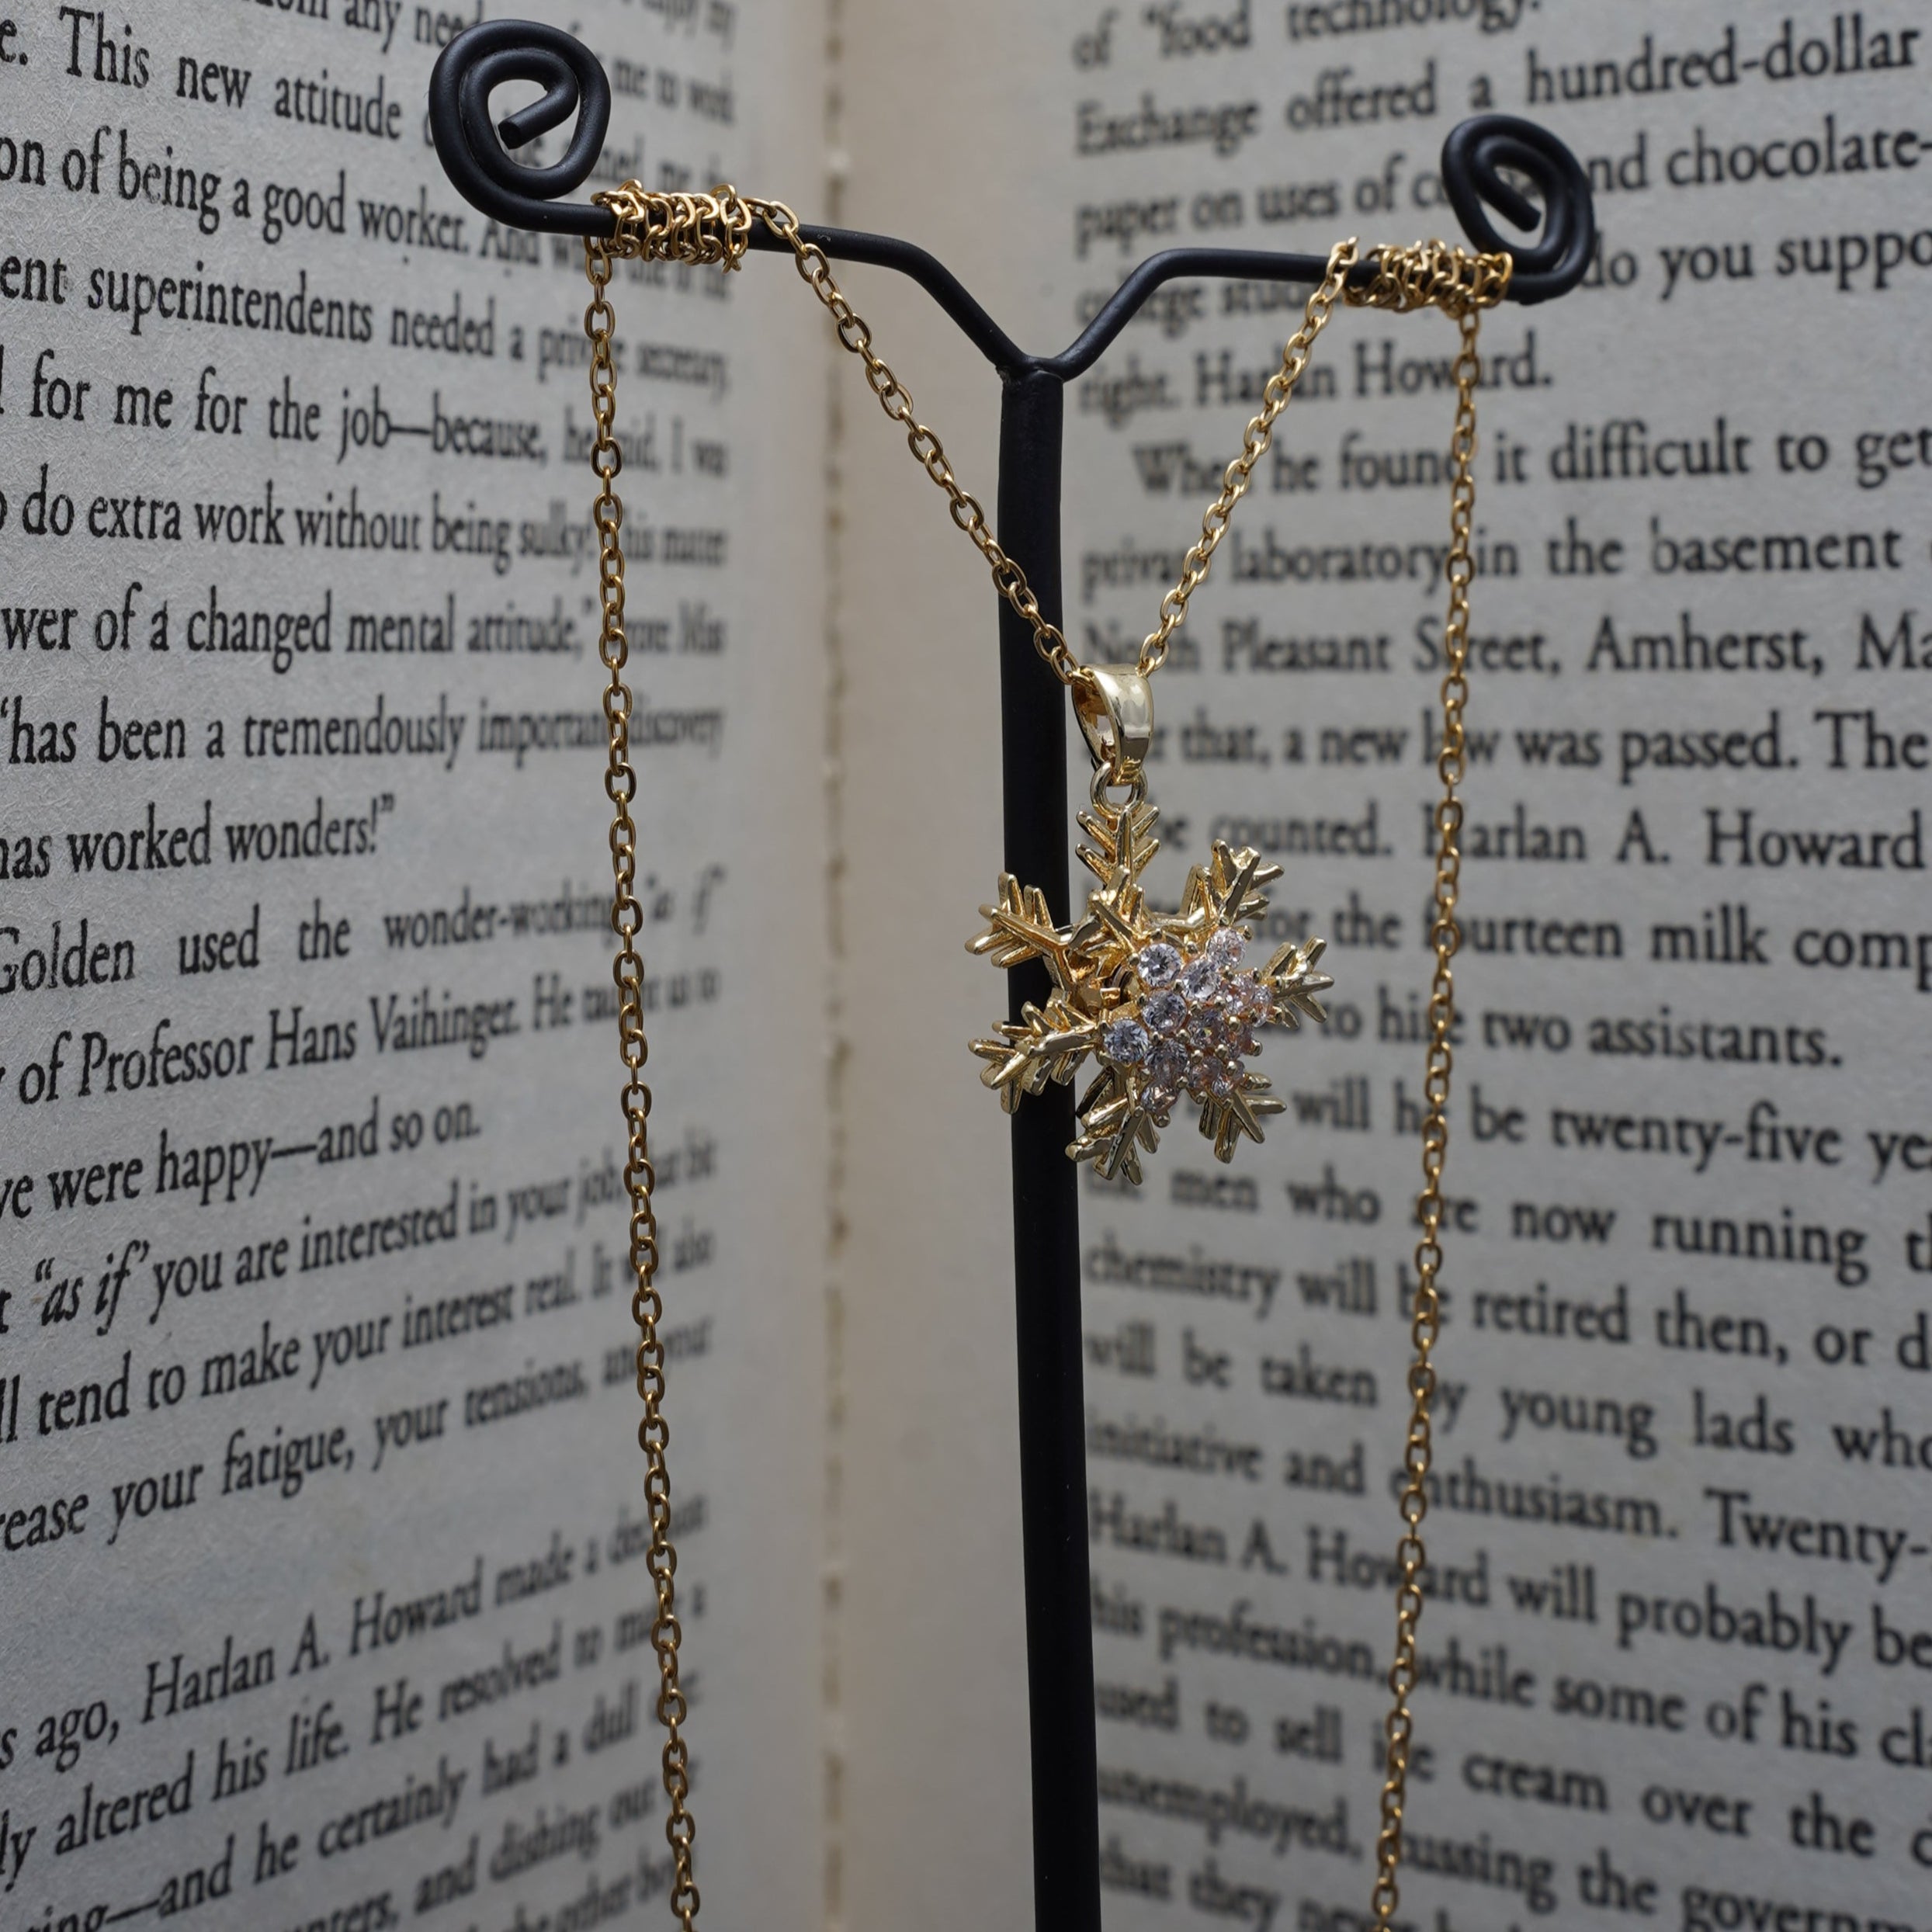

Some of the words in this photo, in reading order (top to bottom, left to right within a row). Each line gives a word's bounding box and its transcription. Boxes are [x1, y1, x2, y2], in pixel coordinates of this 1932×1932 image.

[60, 6, 151, 88] This
[176, 55, 252, 109] new
[275, 70, 401, 141] attitude
[344, 0, 402, 54] any
[1286, 58, 1438, 130] offered
[1470, 73, 1493, 110] a
[1525, 12, 1921, 106] hundred-dollar
[62, 126, 111, 194] of
[119, 129, 221, 234] being
[234, 178, 251, 218] a
[262, 170, 346, 244] good
[359, 186, 470, 254] worker.
[1191, 191, 1243, 229] on
[1257, 182, 1341, 224] uses
[1354, 154, 1407, 214] of
[1667, 113, 1932, 186] chocolate-
[0, 254, 68, 306] ent
[87, 261, 373, 336] superintendents
[390, 292, 496, 357] needed
[509, 327, 523, 360] a
[1659, 242, 1754, 301] you
[29, 349, 90, 421] for
[113, 383, 173, 428] me
[195, 366, 248, 433] for
[269, 375, 321, 441] the
[1271, 432, 1320, 493] he
[1494, 432, 1528, 485] it
[1549, 414, 1753, 482] difficult
[1777, 433, 1830, 473] to
[22, 463, 75, 537] do
[88, 496, 181, 540] extra
[196, 480, 285, 544] work
[296, 485, 422, 550] without
[431, 492, 511, 576] being
[1231, 525, 1450, 595] laboratory
[1475, 525, 1520, 578] in
[1548, 515, 1625, 578] the
[1649, 514, 1903, 575] basement
[94, 581, 142, 651] of
[150, 601, 169, 652] a
[187, 585, 331, 674] changed
[345, 591, 455, 653] mental
[1219, 617, 1393, 674] Pleasant
[1586, 611, 1826, 678] Amherst,
[98, 695, 186, 762] been
[206, 720, 224, 758] a
[244, 692, 467, 772] tremendously
[1285, 728, 1304, 763] a
[1318, 725, 1410, 764] new
[1514, 727, 1604, 770] was
[1618, 708, 1798, 788] passed.
[1814, 708, 1931, 771] The
[68, 800, 211, 872] worked
[226, 794, 395, 863] wonders!”
[1615, 805, 1670, 865] A.
[1704, 807, 1927, 871] Howard
[179, 903, 260, 975] used
[299, 898, 351, 962] the
[1331, 890, 1403, 949] the
[1648, 903, 1770, 966] milk
[19, 1031, 72, 1105] of
[78, 1018, 254, 1097] Professor
[265, 1007, 356, 1070] Hans
[370, 987, 519, 1059] Vaihinger.
[532, 973, 573, 1031] He
[1320, 998, 1362, 1040] to
[1482, 1010, 1573, 1052] two
[1587, 1004, 1844, 1070] assistants.
[48, 1157, 144, 1212] were
[390, 1107, 423, 1151] so
[435, 1101, 482, 1143] on.
[1292, 1077, 1372, 1132] will
[1472, 1081, 1526, 1143] be
[1550, 1098, 1844, 1174] twenty-five
[35, 1257, 83, 1327] “as
[150, 1252, 223, 1324] you
[236, 1243, 290, 1286] are
[300, 1179, 459, 1274] interested
[470, 1181, 496, 1234] in
[505, 1178, 570, 1240] your
[1288, 1163, 1382, 1226] who
[1510, 1200, 1617, 1243] now
[1652, 1208, 1870, 1289] running
[38, 1351, 130, 1437] tend
[147, 1365, 185, 1410] to
[201, 1321, 301, 1396] make
[310, 1316, 393, 1390] your
[402, 1285, 515, 1350] interest
[1296, 1257, 1379, 1316] will
[1472, 1282, 1631, 1346] retired
[1656, 1288, 1789, 1366] then,
[1813, 1323, 1874, 1366] or
[1182, 1326, 1234, 1389] be
[1261, 1341, 1380, 1407] taken
[1499, 1387, 1658, 1461] young
[1692, 1387, 1796, 1456] lads
[0, 1493, 88, 1552] ease
[107, 1463, 203, 1545] your
[222, 1428, 354, 1498] fatigue,
[373, 1396, 449, 1471] your
[1285, 1441, 1367, 1497] and
[1703, 1486, 1929, 1585] Twenty-
[0, 1728, 16, 1771] s
[36, 1701, 120, 1772] ago,
[141, 1635, 275, 1724] Harlan
[290, 1612, 329, 1677] A.
[349, 1555, 483, 1656] Howard
[496, 1530, 575, 1606] made
[1507, 1564, 1597, 1626] will
[1618, 1583, 1853, 1677] probably
[1871, 1603, 1932, 1670] be
[55, 1750, 195, 1856] altered
[212, 1739, 269, 1802] his
[286, 1702, 349, 1776] life.
[371, 1677, 424, 1744] He
[439, 1619, 561, 1722] resolved
[1554, 1676, 1687, 1733] some
[1706, 1683, 1768, 1744] of
[1781, 1689, 1860, 1757] his
[254, 1821, 300, 1886] he
[317, 1754, 467, 1861] certainly
[481, 1722, 539, 1795] had
[1464, 1750, 1611, 1814] cream
[1642, 1785, 1753, 1837] over
[1790, 1792, 1875, 1859] the
[414, 1833, 479, 1916] and
[1577, 1848, 1658, 1916] the
